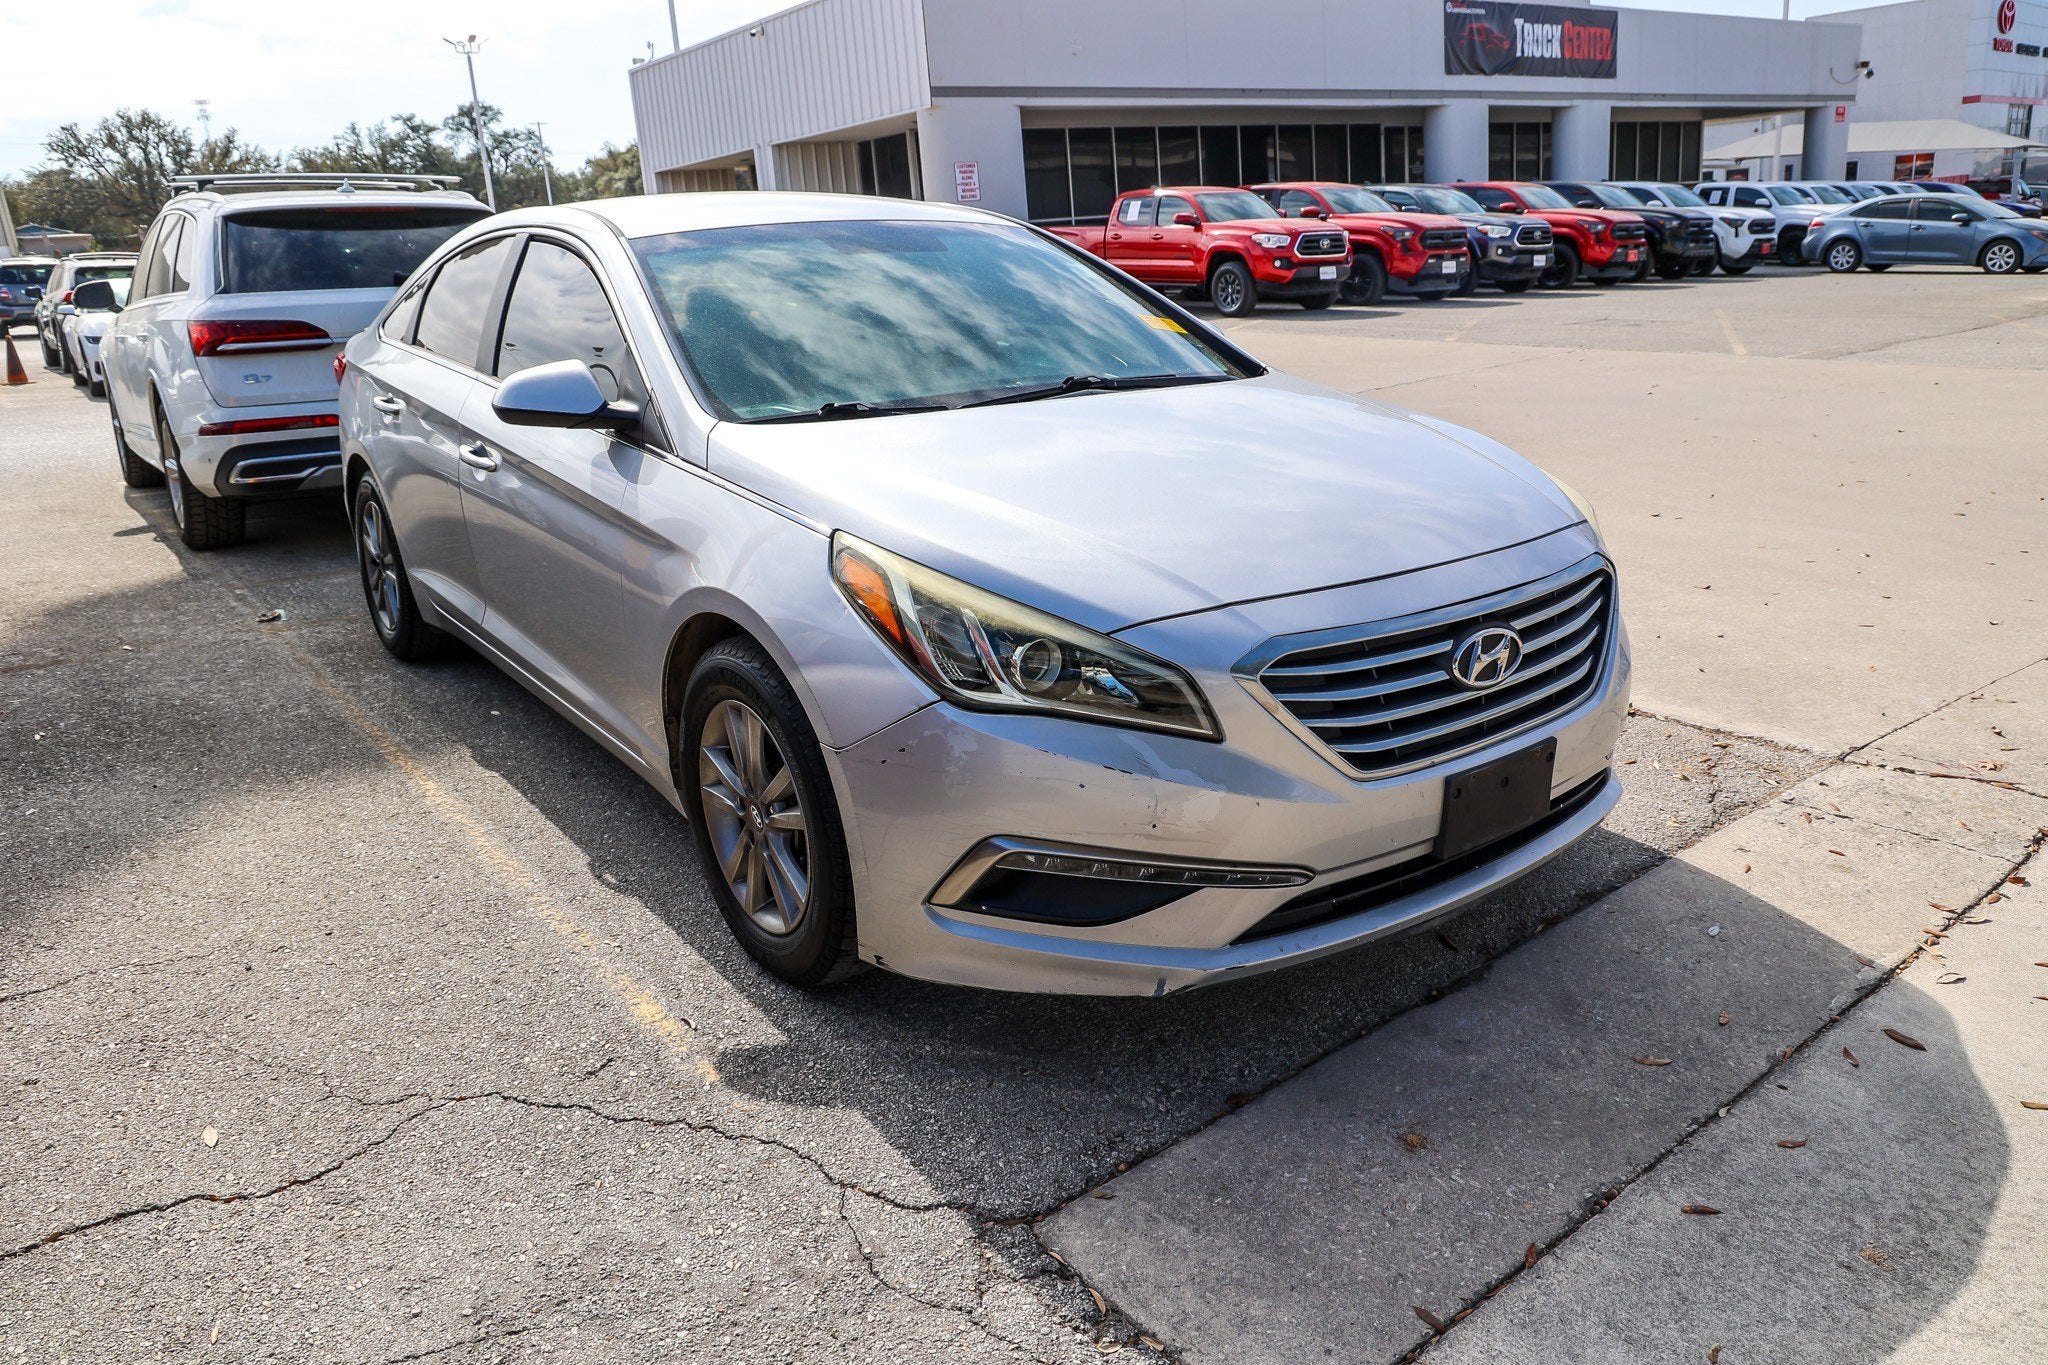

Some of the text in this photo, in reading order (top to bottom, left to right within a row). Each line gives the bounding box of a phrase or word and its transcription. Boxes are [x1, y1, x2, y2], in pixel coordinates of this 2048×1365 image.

[1514, 18, 1613, 60] TRUCK CENTER
[243, 374, 272, 385] Q7
